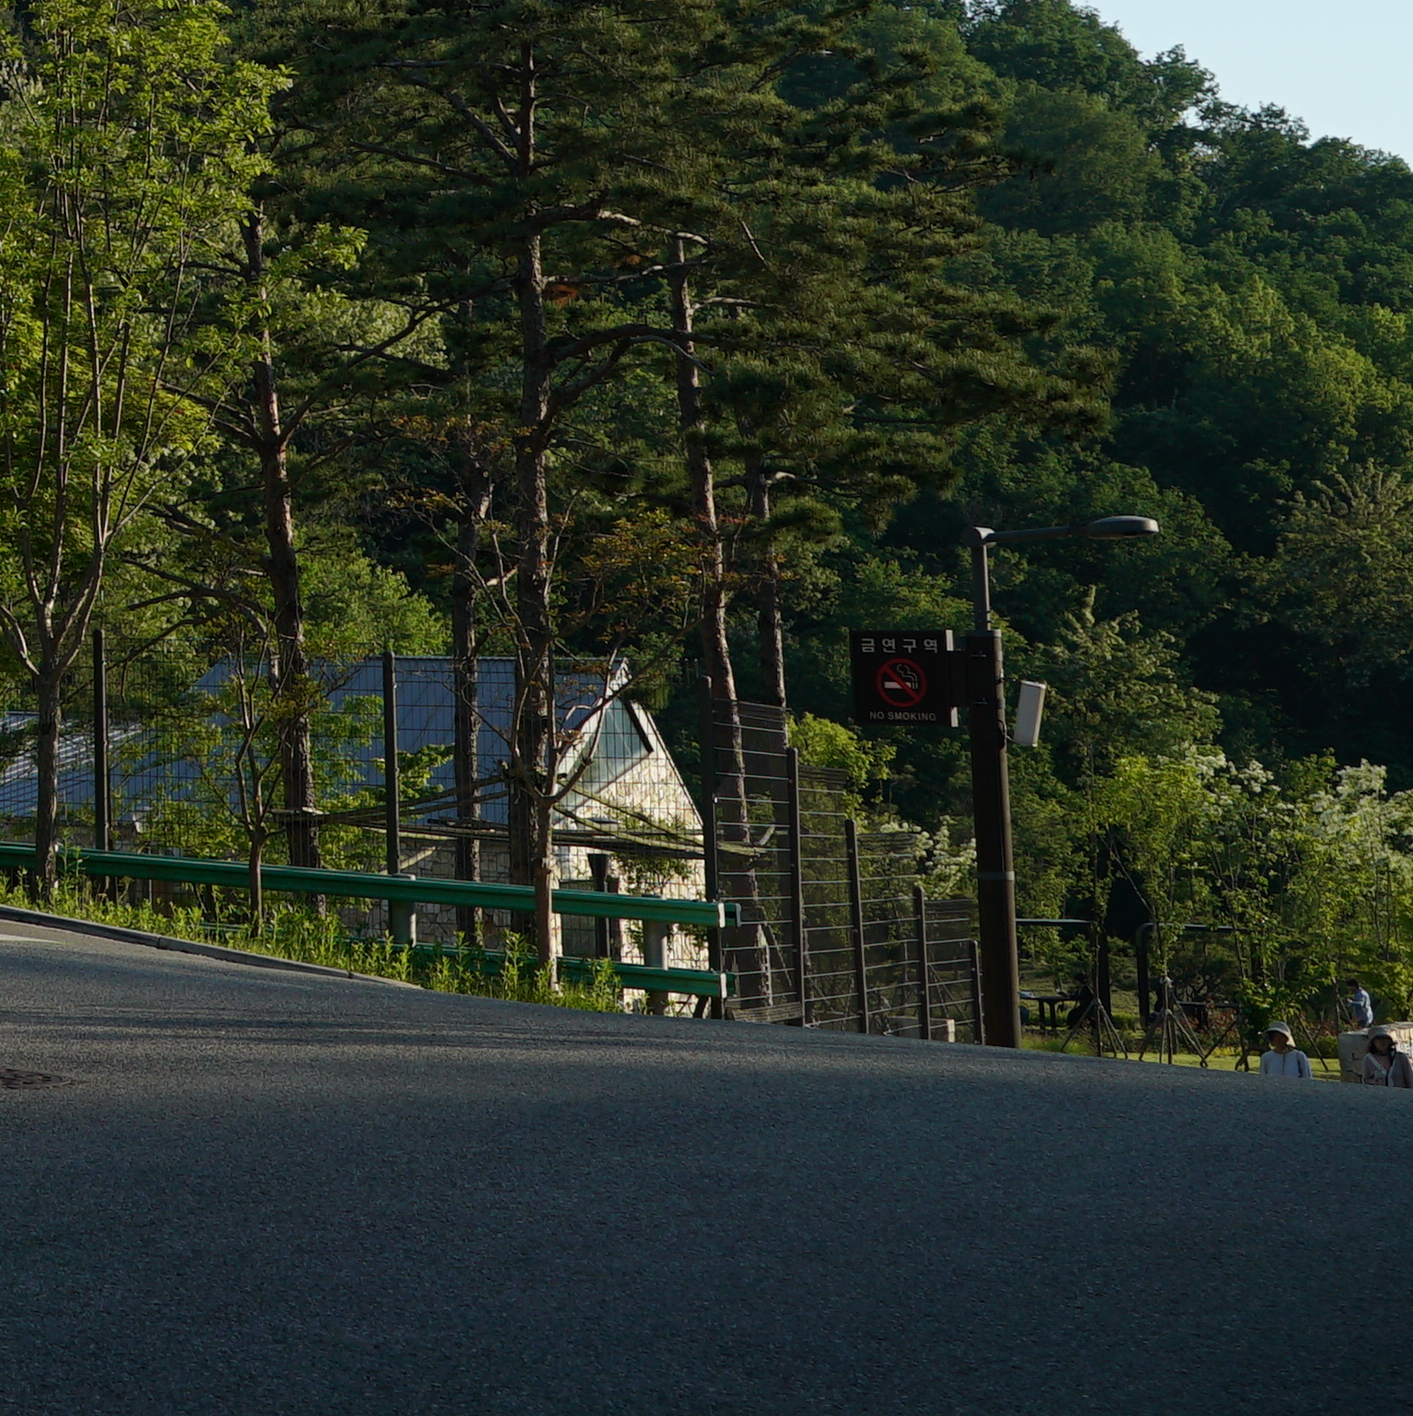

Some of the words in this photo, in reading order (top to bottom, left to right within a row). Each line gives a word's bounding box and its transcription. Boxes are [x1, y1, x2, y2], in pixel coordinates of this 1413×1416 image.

[860, 637, 938, 654] 금연구역
[869, 711, 885, 720] NO
[887, 711, 937, 721] SMOKING
